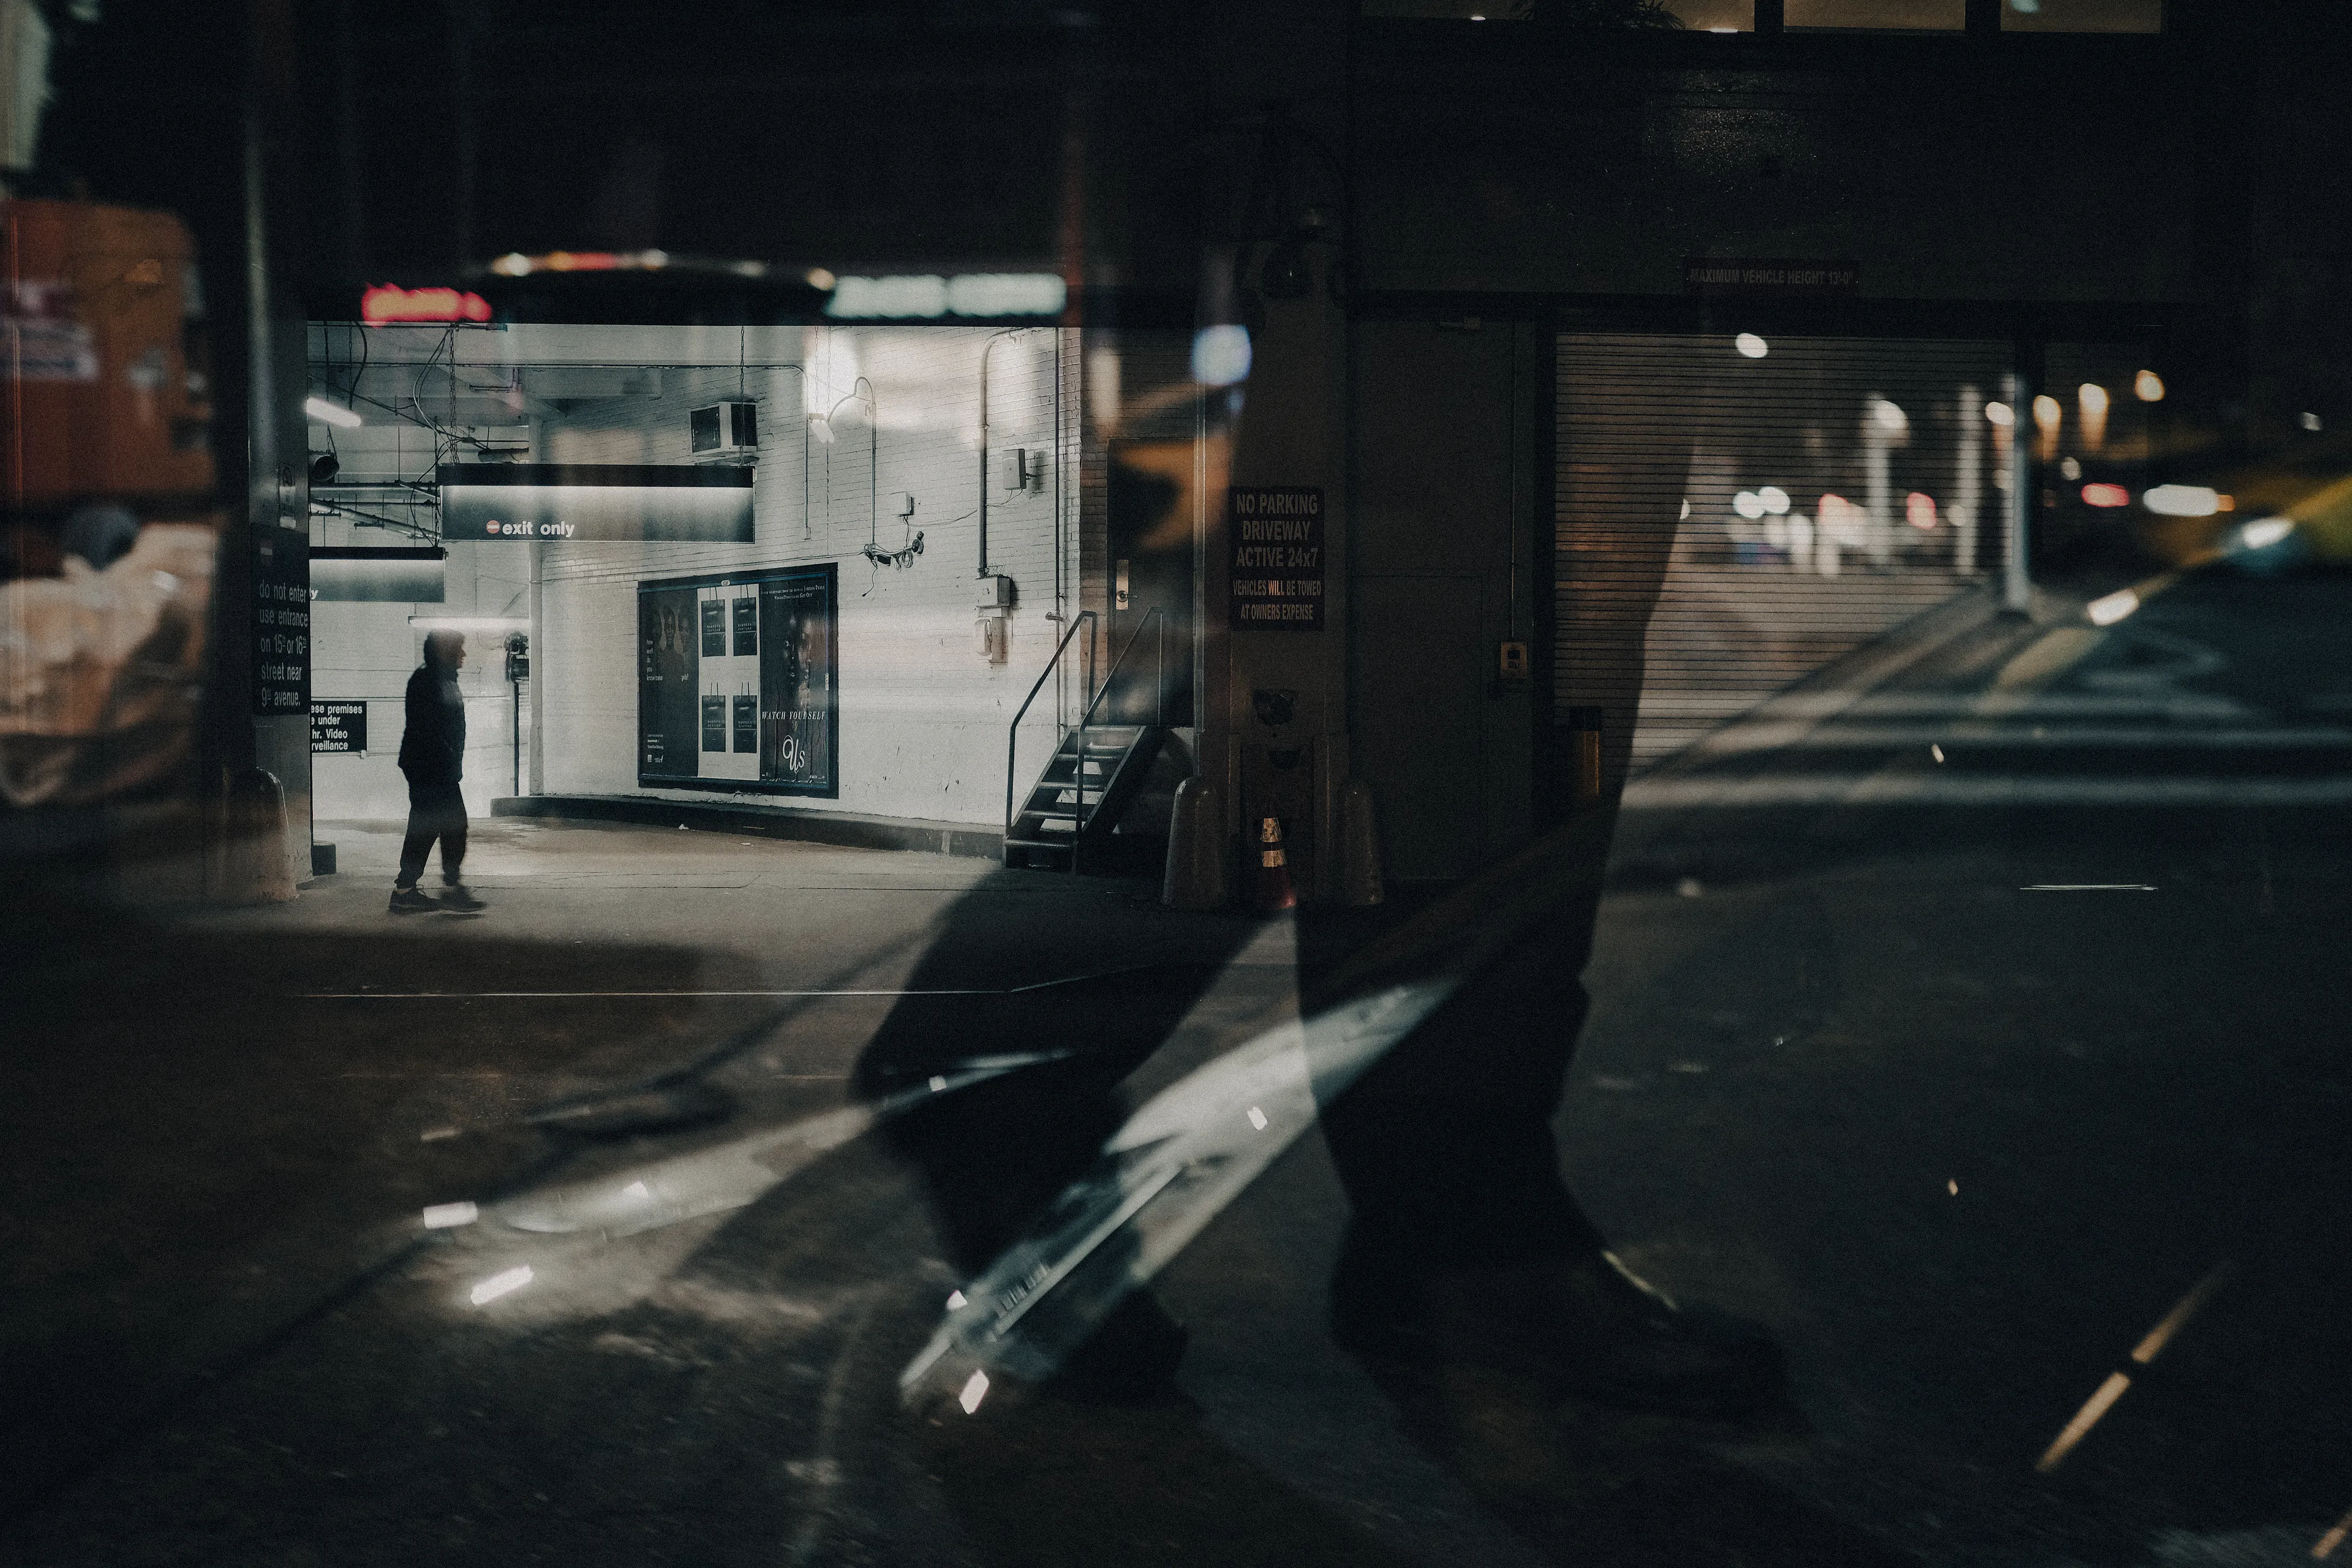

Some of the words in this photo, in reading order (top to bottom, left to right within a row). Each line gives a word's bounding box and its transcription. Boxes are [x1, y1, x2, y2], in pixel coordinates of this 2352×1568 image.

[1690, 269, 1740, 283] MAXIMUM
[1742, 270, 1785, 284] VEHICLE
[1788, 270, 1825, 284] HEIGHT
[1237, 494, 1256, 514] NO
[1259, 494, 1318, 514] PARKING
[502, 520, 533, 535] exit
[540, 521, 575, 538] only
[1243, 520, 1311, 540] DRIVEWAY
[1236, 546, 1284, 567] ACTIVE
[1287, 547, 1318, 567] 24x7
[259, 579, 270, 599] do
[274, 582, 286, 601] not
[289, 584, 307, 603] enter
[1234, 579, 1267, 596] VEHICLES
[1268, 579, 1284, 596] WILL
[1286, 580, 1296, 596] BE
[1298, 580, 1321, 596] TOWED
[259, 608, 274, 624] use
[278, 608, 308, 627] entrance
[1241, 604, 1250, 620] AT
[1251, 604, 1280, 620] OWNERS
[1282, 604, 1313, 620] EXPENSE
[260, 637, 271, 652] on
[287, 639, 294, 654] or
[262, 662, 284, 680] street
[287, 666, 302, 680] near
[274, 691, 301, 707] avenue.
[311, 704, 325, 714] ese
[328, 703, 363, 716] premises
[762, 710, 786, 720] WATCH
[789, 710, 826, 720] YOURSELF
[318, 715, 341, 725] under
[312, 728, 322, 739] hr.
[325, 728, 348, 739] Video
[311, 740, 349, 751] rveillance
[783, 734, 805, 774] Us
